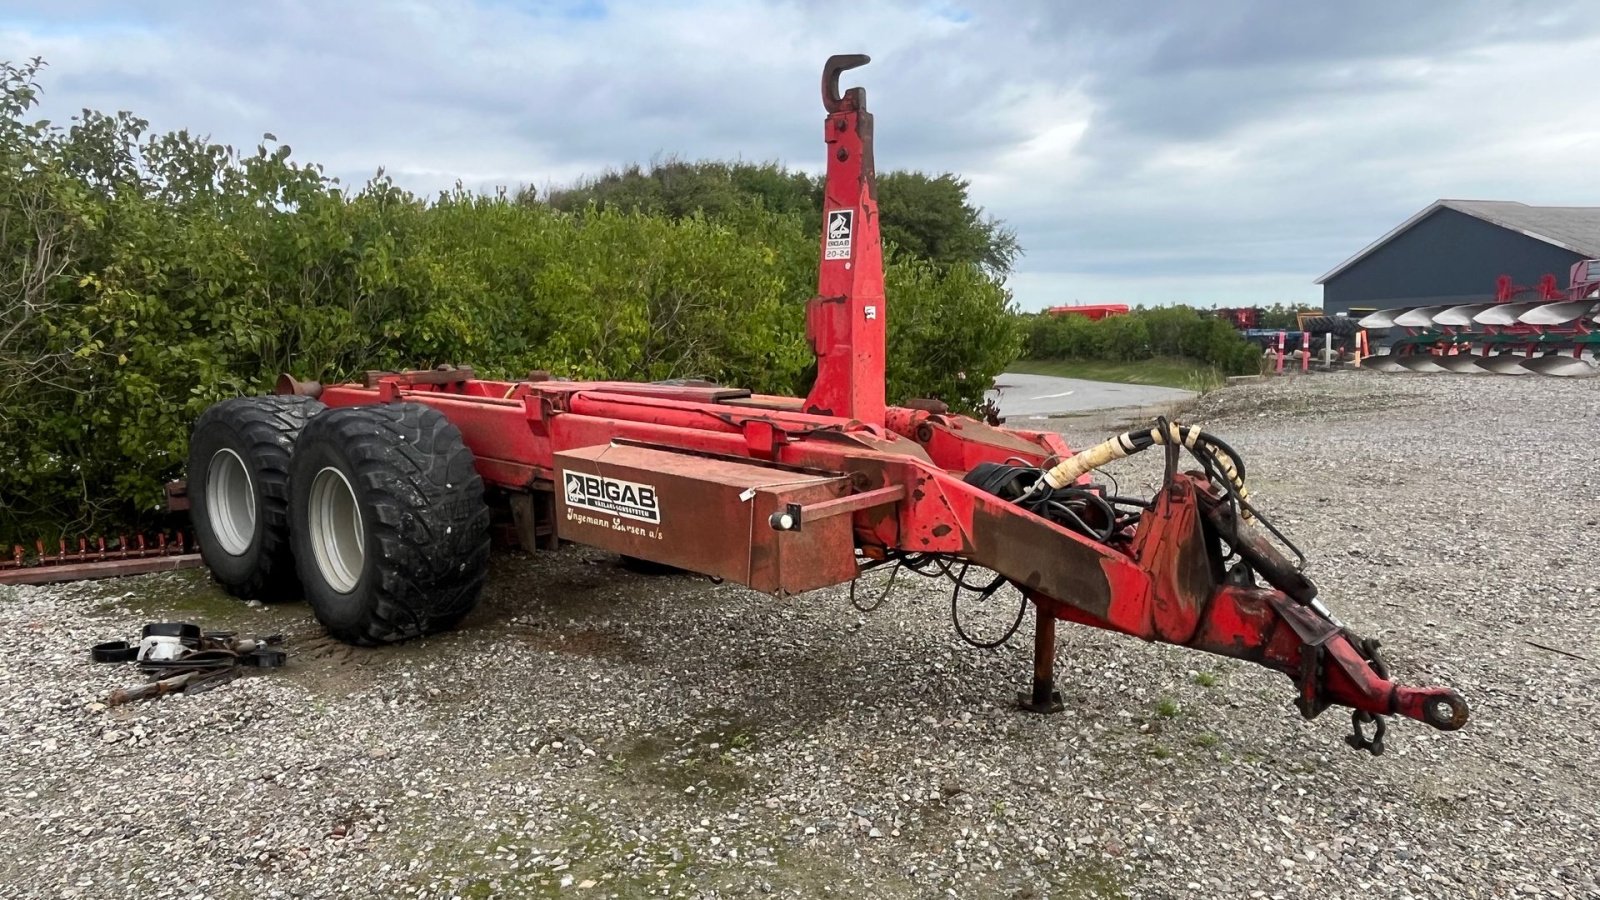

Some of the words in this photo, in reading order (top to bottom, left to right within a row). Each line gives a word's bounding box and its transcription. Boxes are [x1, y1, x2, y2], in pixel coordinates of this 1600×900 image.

[828, 239, 850, 247] BIGAB
[826, 250, 850, 258] 20-24
[585, 477, 656, 508] BIGAB
[567, 507, 609, 528] Ingemann
